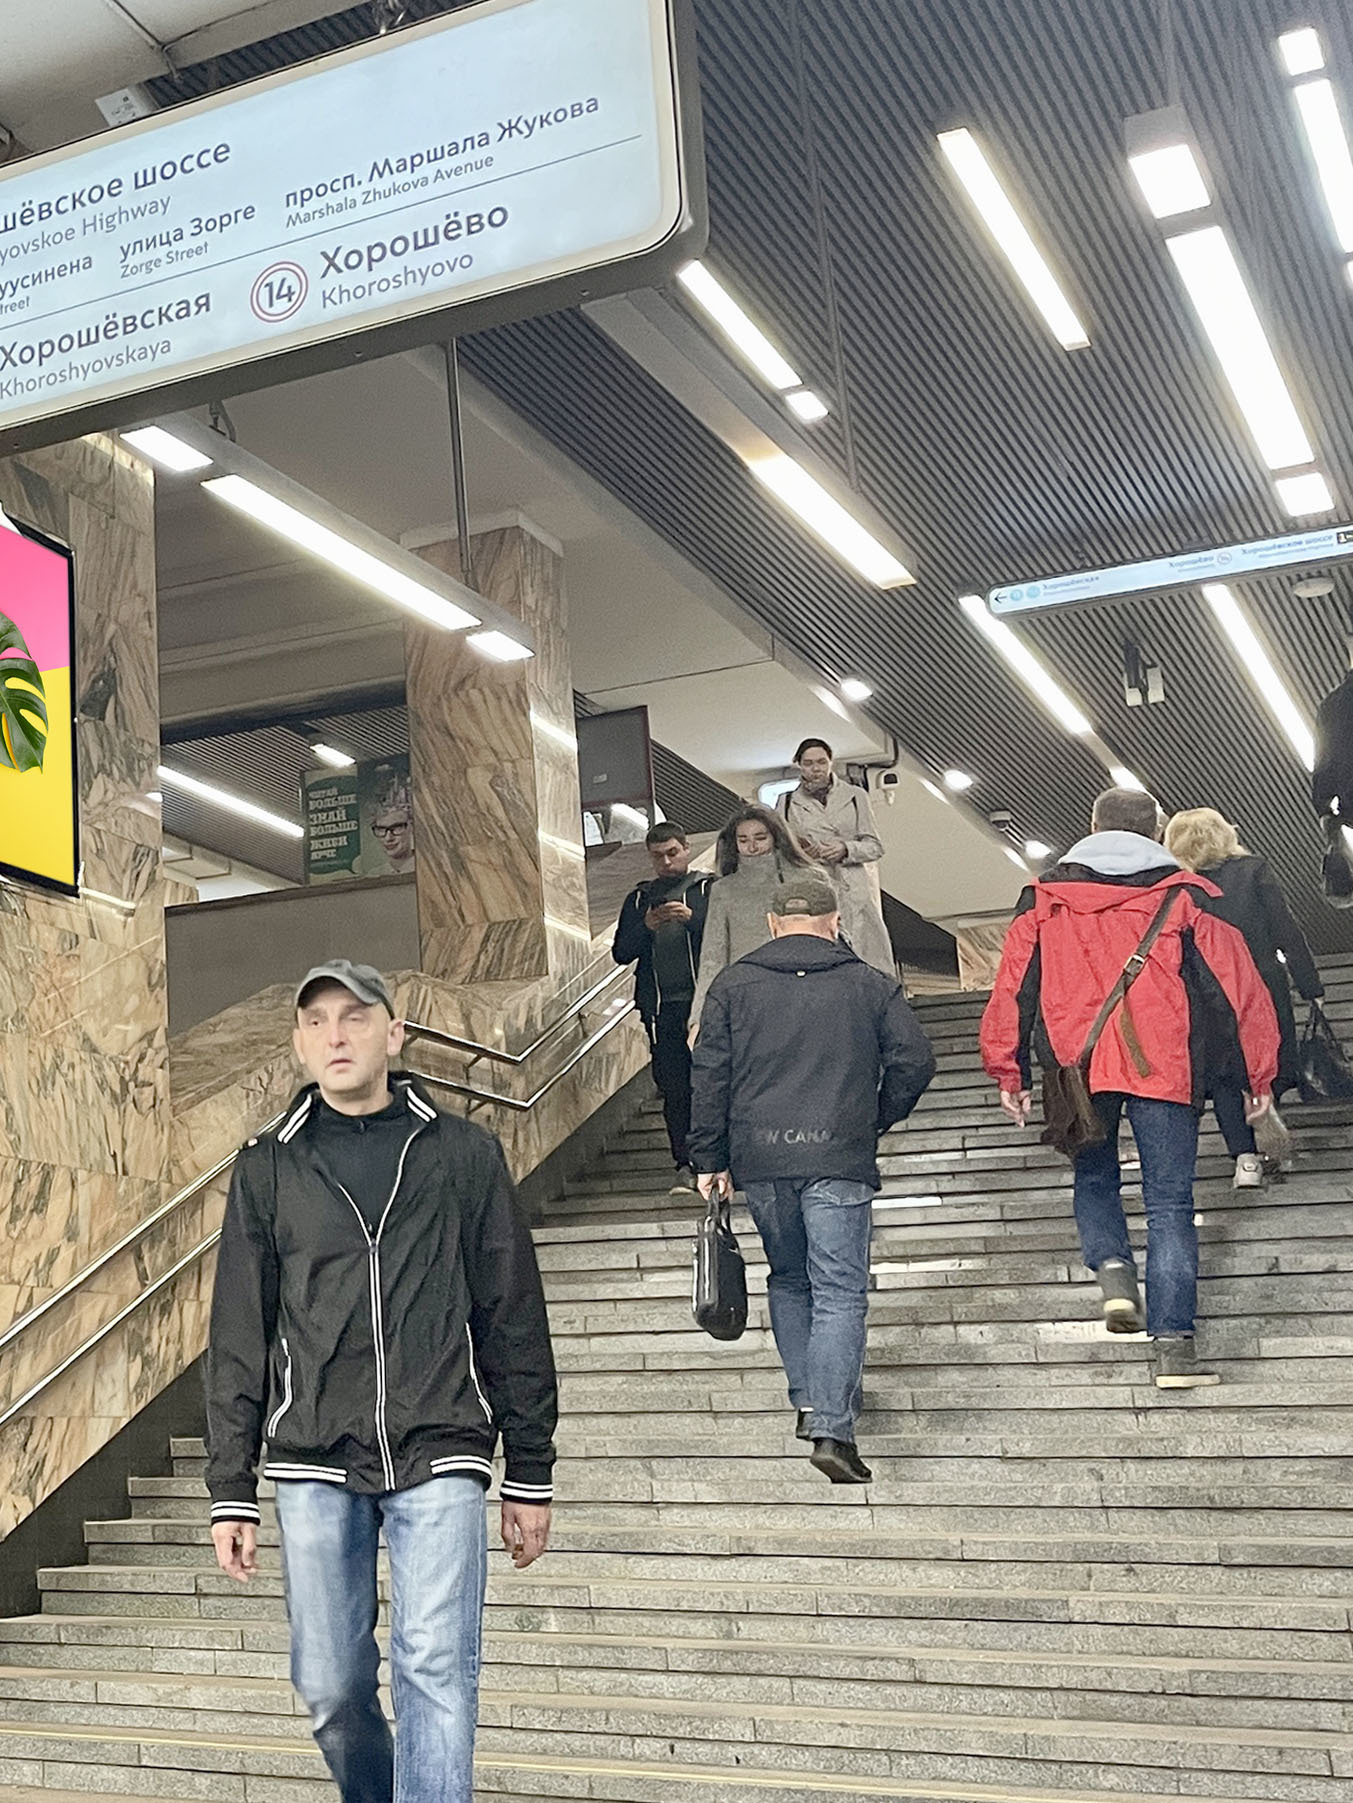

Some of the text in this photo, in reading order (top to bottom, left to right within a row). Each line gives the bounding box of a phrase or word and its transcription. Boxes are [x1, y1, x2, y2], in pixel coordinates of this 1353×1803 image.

[133, 143, 231, 190] шоссе
[285, 96, 600, 208] просп. Маршала Жукова
[83, 195, 172, 236] Highway
[285, 153, 494, 229] Marshala Zhukova Avenue
[119, 203, 256, 262] улица Зорге
[120, 242, 210, 279] Zorge Street
[319, 205, 510, 279] Хорошёво
[262, 276, 297, 309] 14
[321, 252, 474, 310] Khoroshyovo
